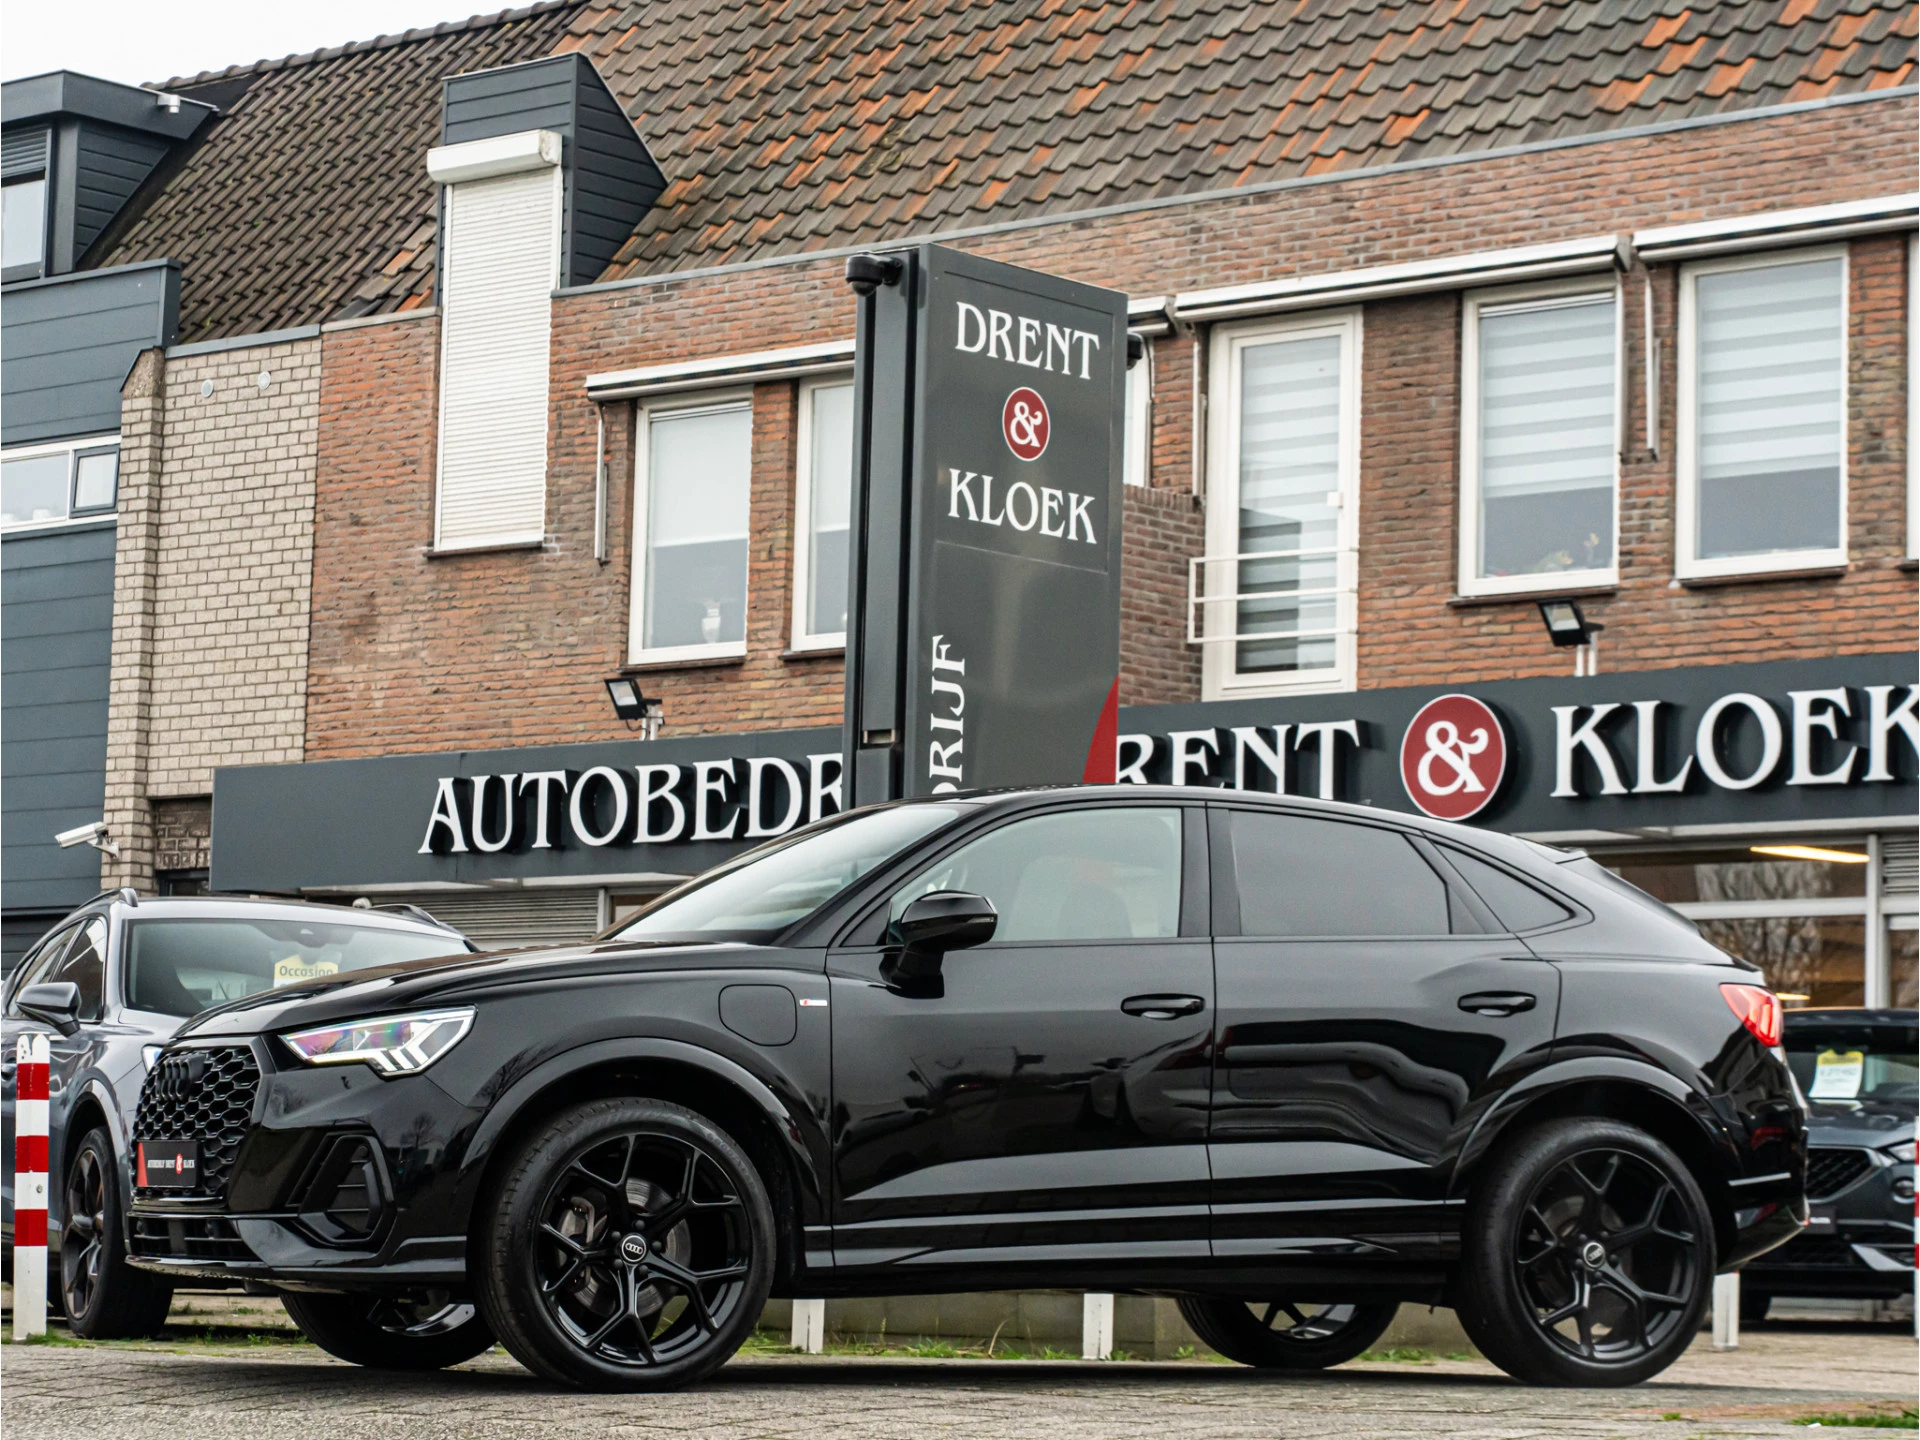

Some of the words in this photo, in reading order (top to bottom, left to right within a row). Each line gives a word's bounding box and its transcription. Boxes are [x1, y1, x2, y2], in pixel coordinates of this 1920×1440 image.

[955, 301, 1100, 380] DRENT
[1009, 401, 1043, 448] &
[948, 467, 1097, 545] KLOEK
[929, 634, 965, 795] RIJF
[1417, 720, 1490, 797] &
[1550, 684, 1919, 797] KLOEK
